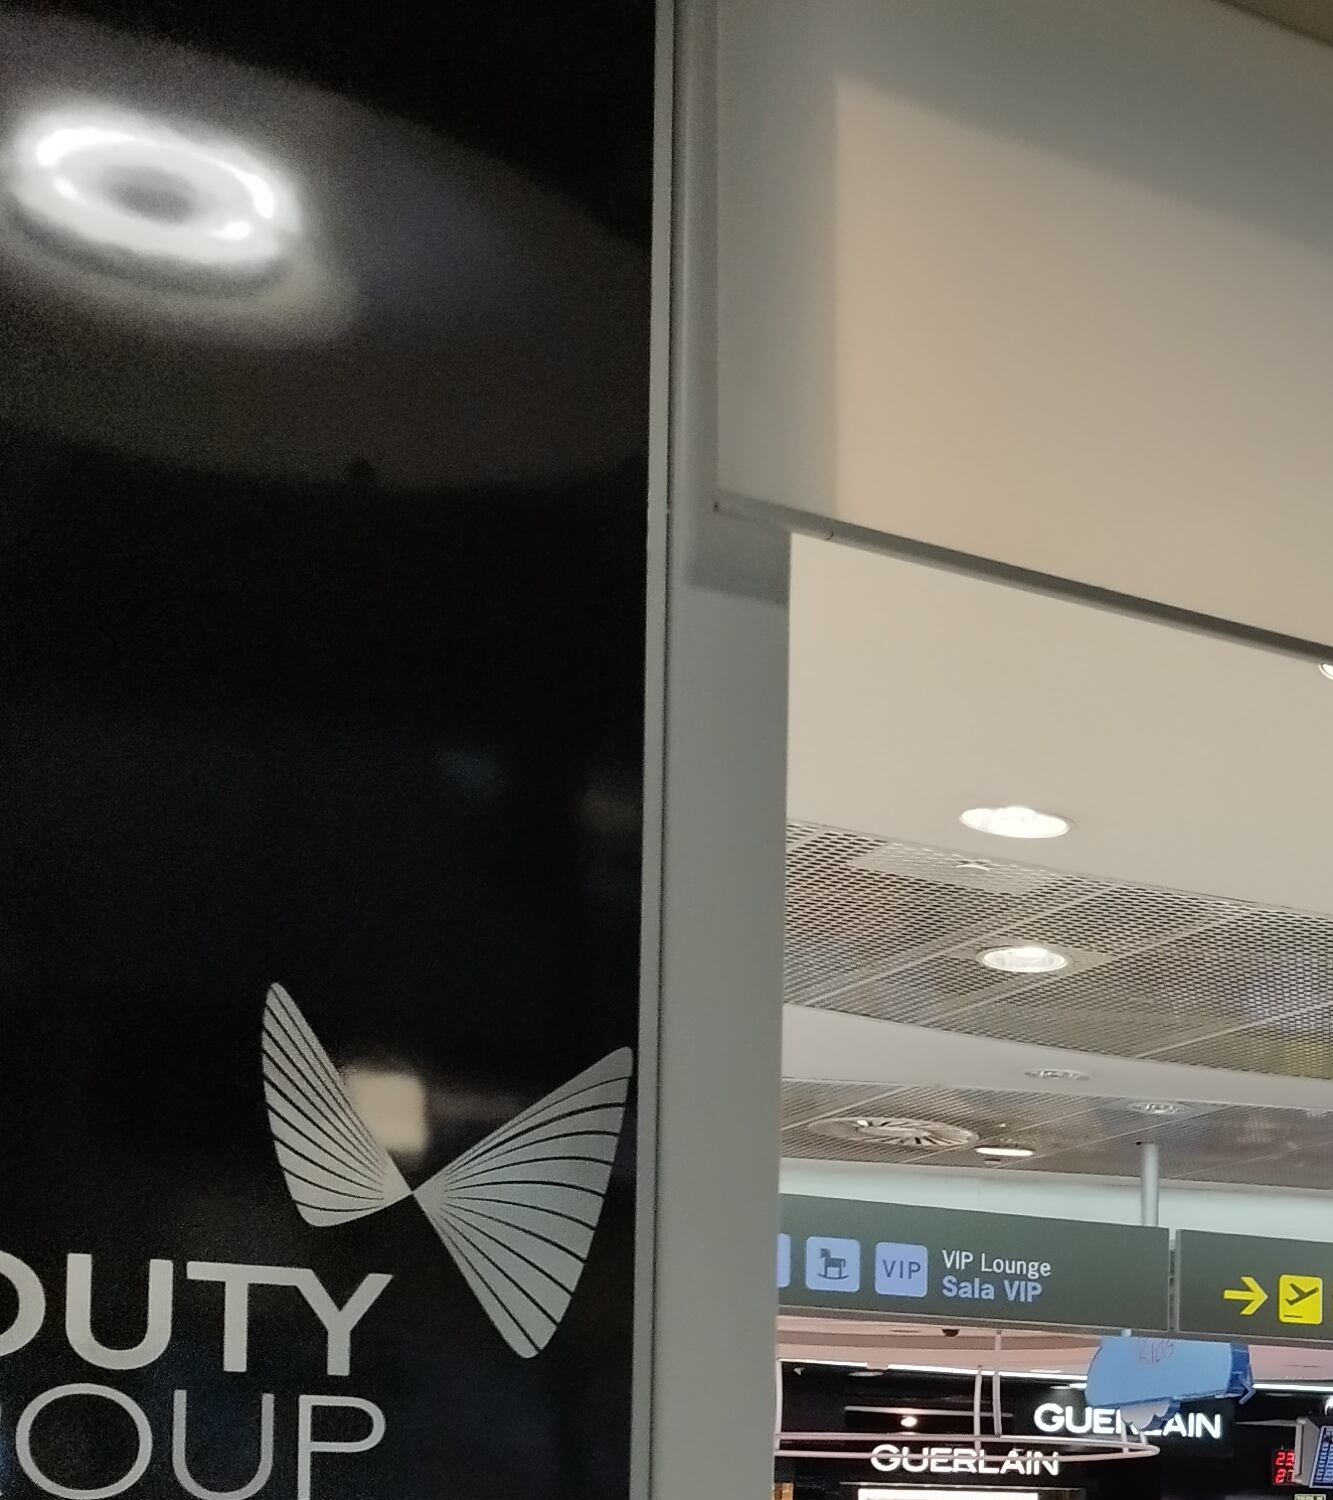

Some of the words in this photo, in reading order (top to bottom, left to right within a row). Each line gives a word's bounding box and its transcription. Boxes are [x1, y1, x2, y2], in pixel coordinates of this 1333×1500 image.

[883, 1259, 921, 1280] VIP
[942, 1249, 974, 1270] VIP
[981, 1253, 1051, 1280] Lounge
[942, 1274, 995, 1300] Sala
[1003, 1279, 1042, 1302] VIP
[1034, 1403, 1221, 1439] GUEAIN
[870, 1444, 1060, 1476] GUERLAIN
